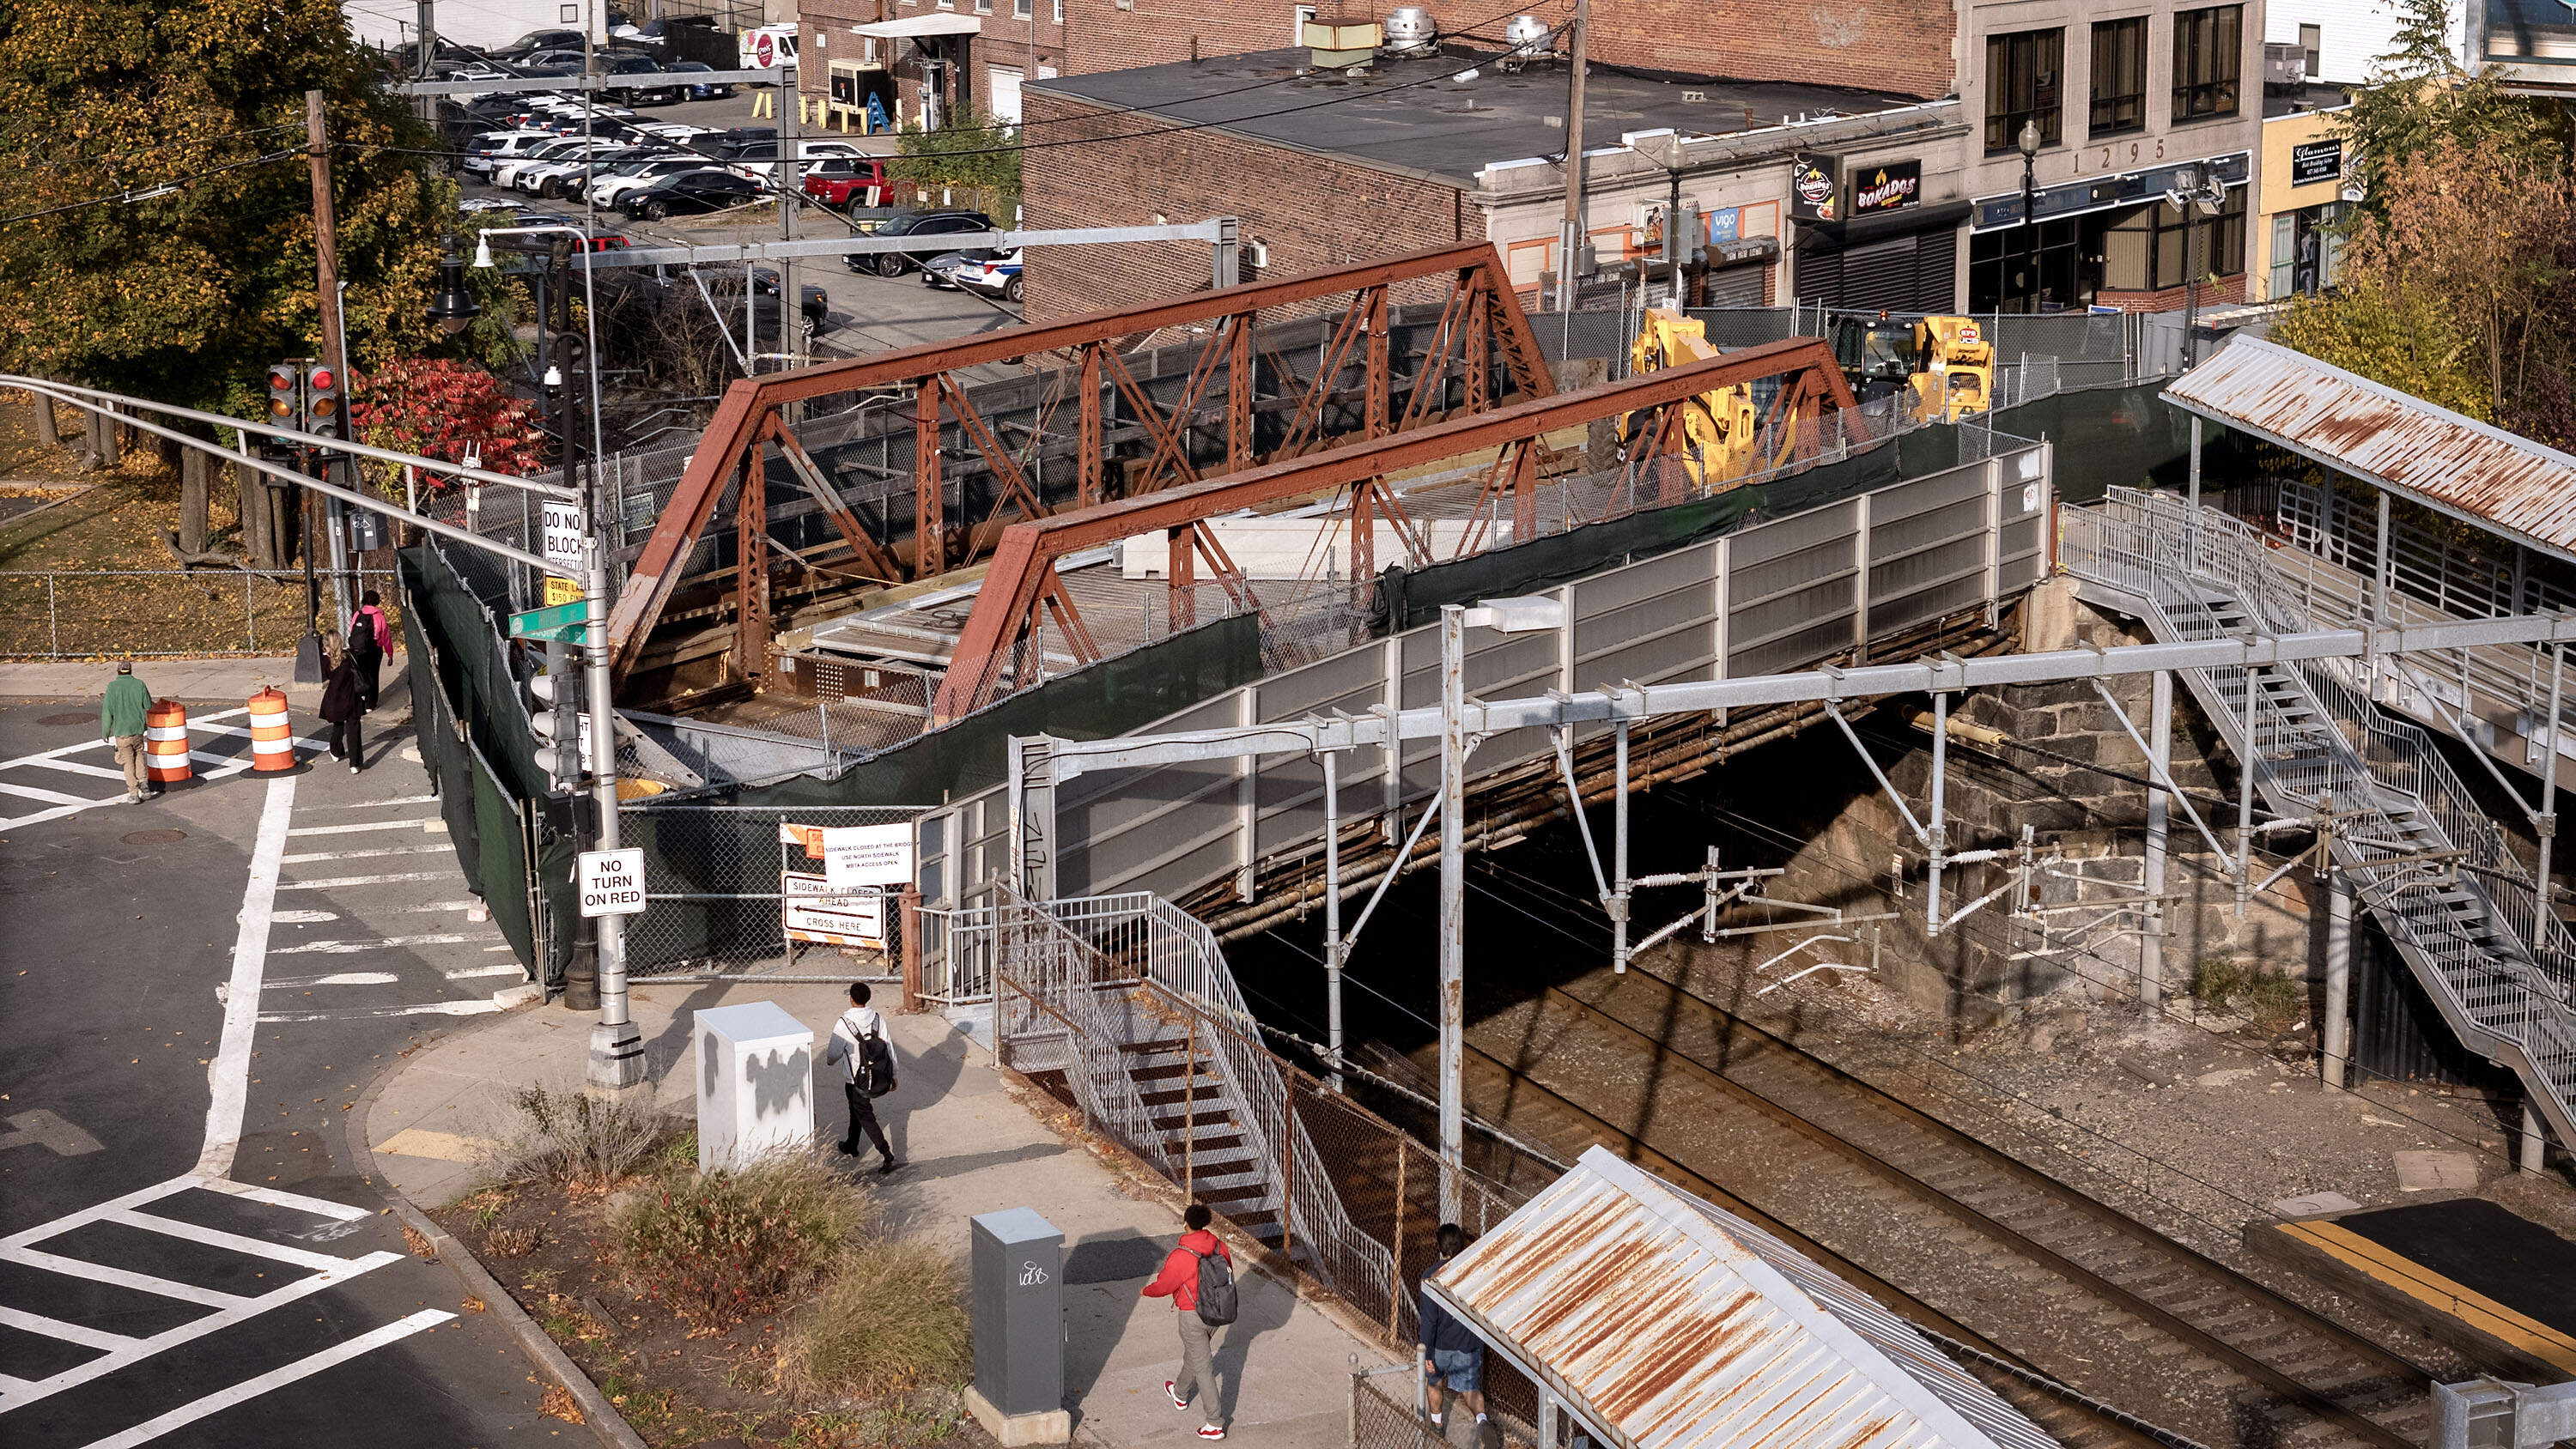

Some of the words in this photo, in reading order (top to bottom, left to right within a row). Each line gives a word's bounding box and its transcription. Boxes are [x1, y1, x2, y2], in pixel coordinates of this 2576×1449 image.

[2295, 144, 2339, 161] Glamour
[1800, 182, 1831, 191] BOKADOS
[1858, 178, 1916, 208] BOKADOS
[1715, 214, 1735, 228] vigo
[544, 511, 560, 528] DO
[564, 512, 580, 530] NO
[547, 556, 583, 572] TERSECTIO
[550, 580, 568, 591] STATE
[552, 592, 567, 603] $150
[600, 860, 622, 872] NO
[592, 875, 632, 889] TURN
[793, 882, 835, 894] SIDEWALK
[585, 894, 605, 906] ON
[611, 891, 640, 904] RED
[818, 896, 849, 907] AHEAD
[806, 917, 835, 929] CROSS
[839, 920, 862, 931] HERE
